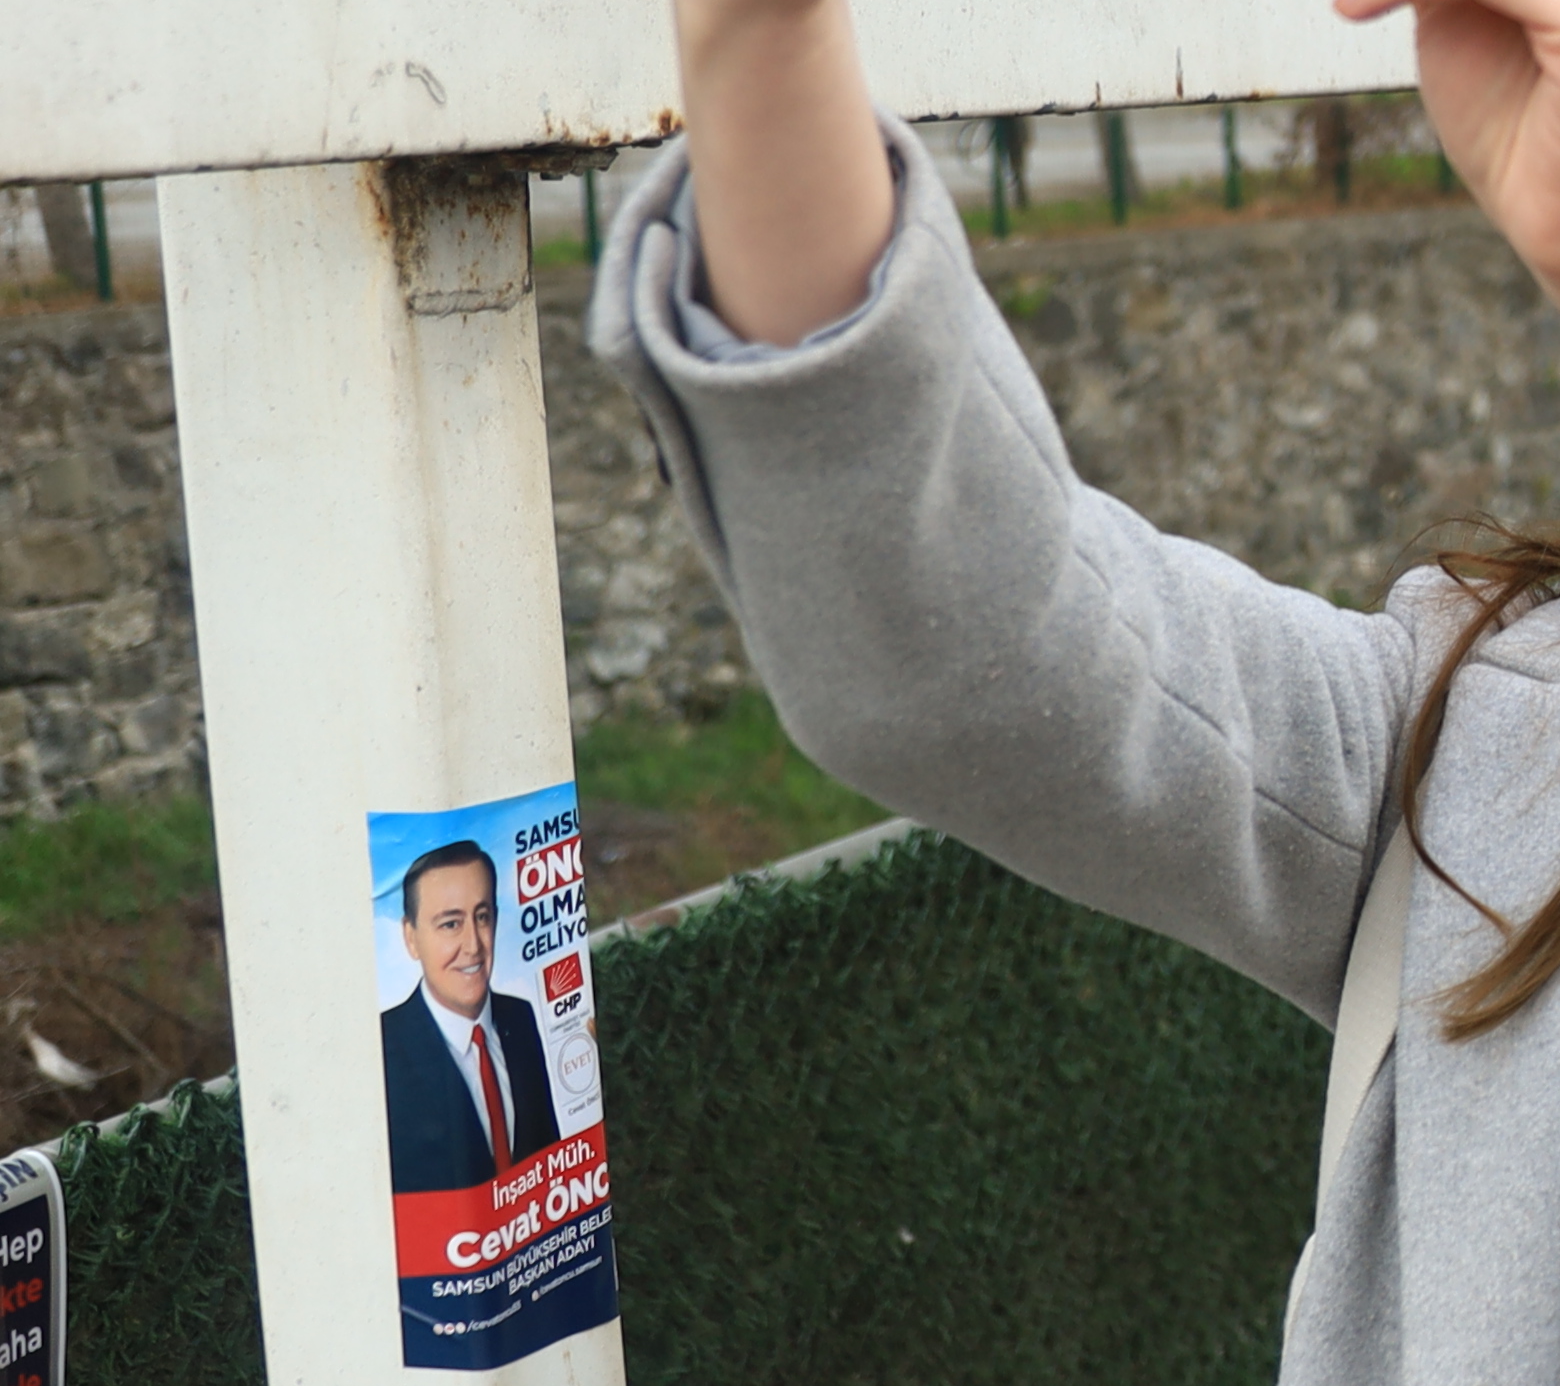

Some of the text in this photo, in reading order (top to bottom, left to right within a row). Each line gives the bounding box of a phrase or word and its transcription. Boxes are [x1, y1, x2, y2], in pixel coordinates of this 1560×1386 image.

[522, 917, 588, 962] GELİYO
[554, 992, 582, 1018] CHP
[563, 1050, 592, 1076] EVET
[492, 1139, 595, 1211] İnşaat Müh.
[446, 1162, 610, 1268] Cevat ÖNC
[432, 1204, 613, 1297] SAMSUN BÜYÜKŞEHİR BELE
[508, 1233, 595, 1296] BAŞKAN ADAYI
